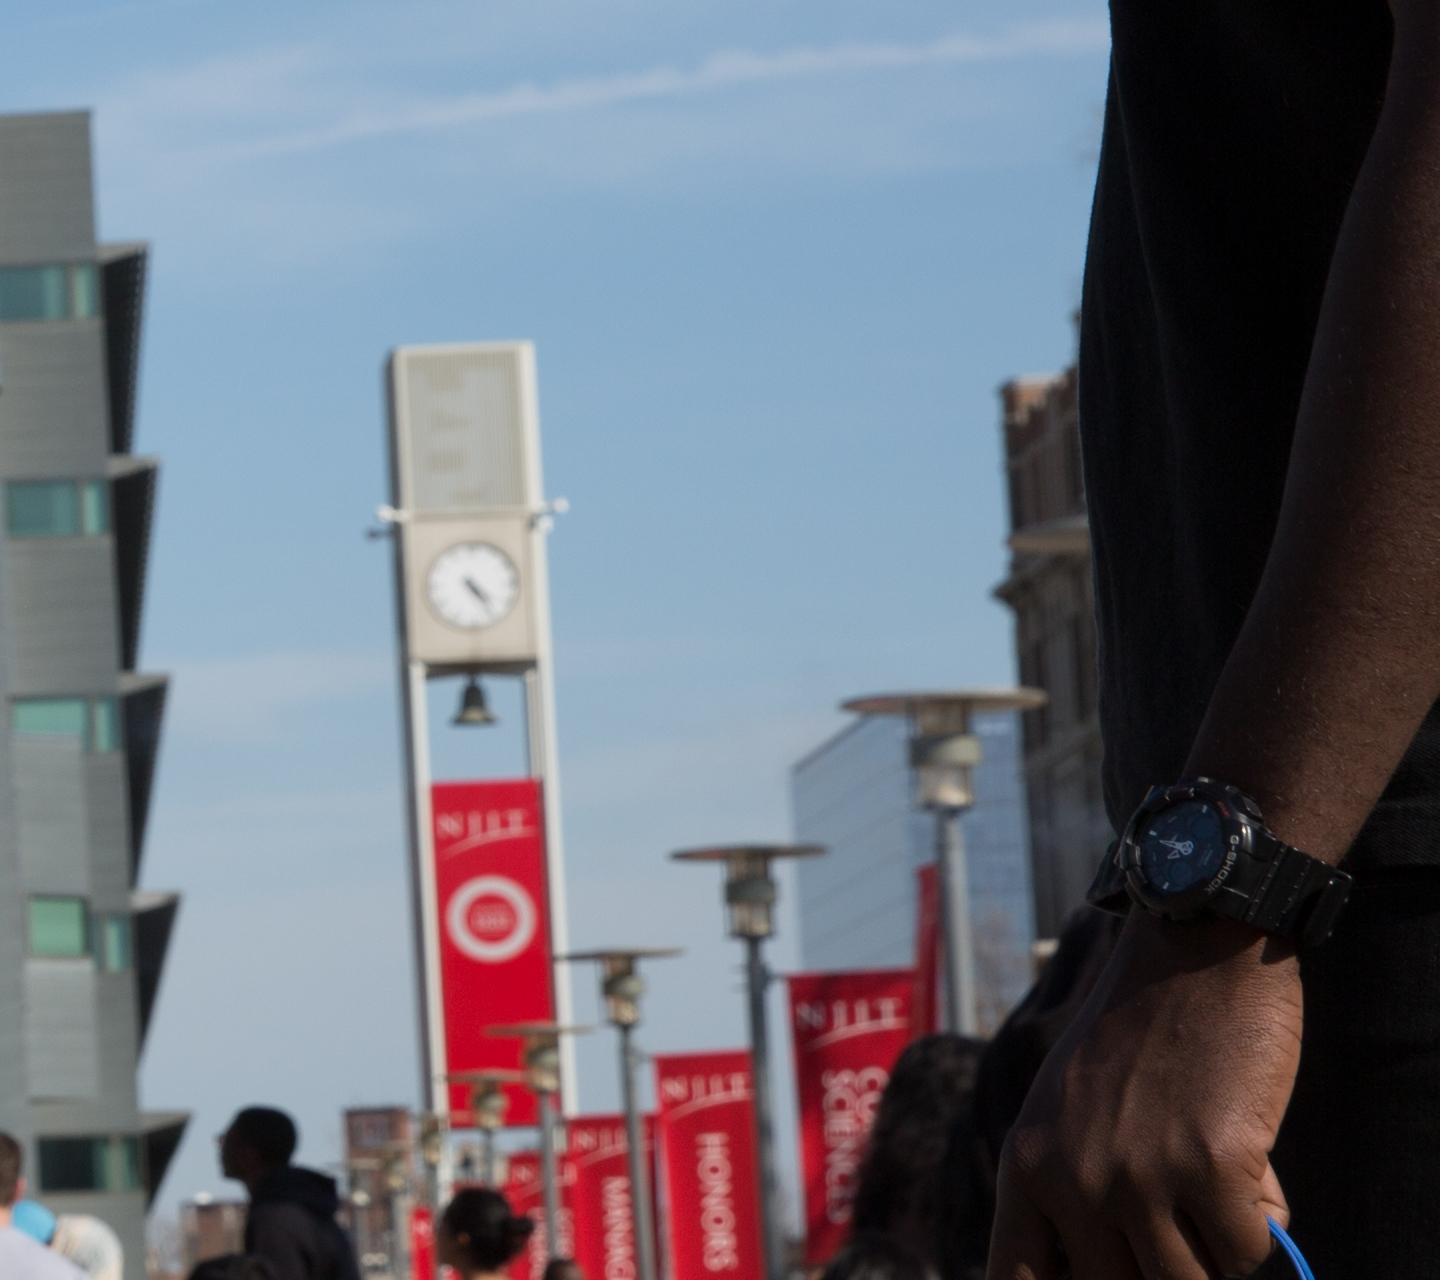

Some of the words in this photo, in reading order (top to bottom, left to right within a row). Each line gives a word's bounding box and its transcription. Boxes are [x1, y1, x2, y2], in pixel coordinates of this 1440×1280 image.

[436, 808, 531, 839] NJIT
[1204, 834, 1240, 896] G-SHOCK
[797, 997, 903, 1030] NJIT
[663, 1072, 752, 1102] NJIT
[695, 1132, 739, 1271] HONORS
